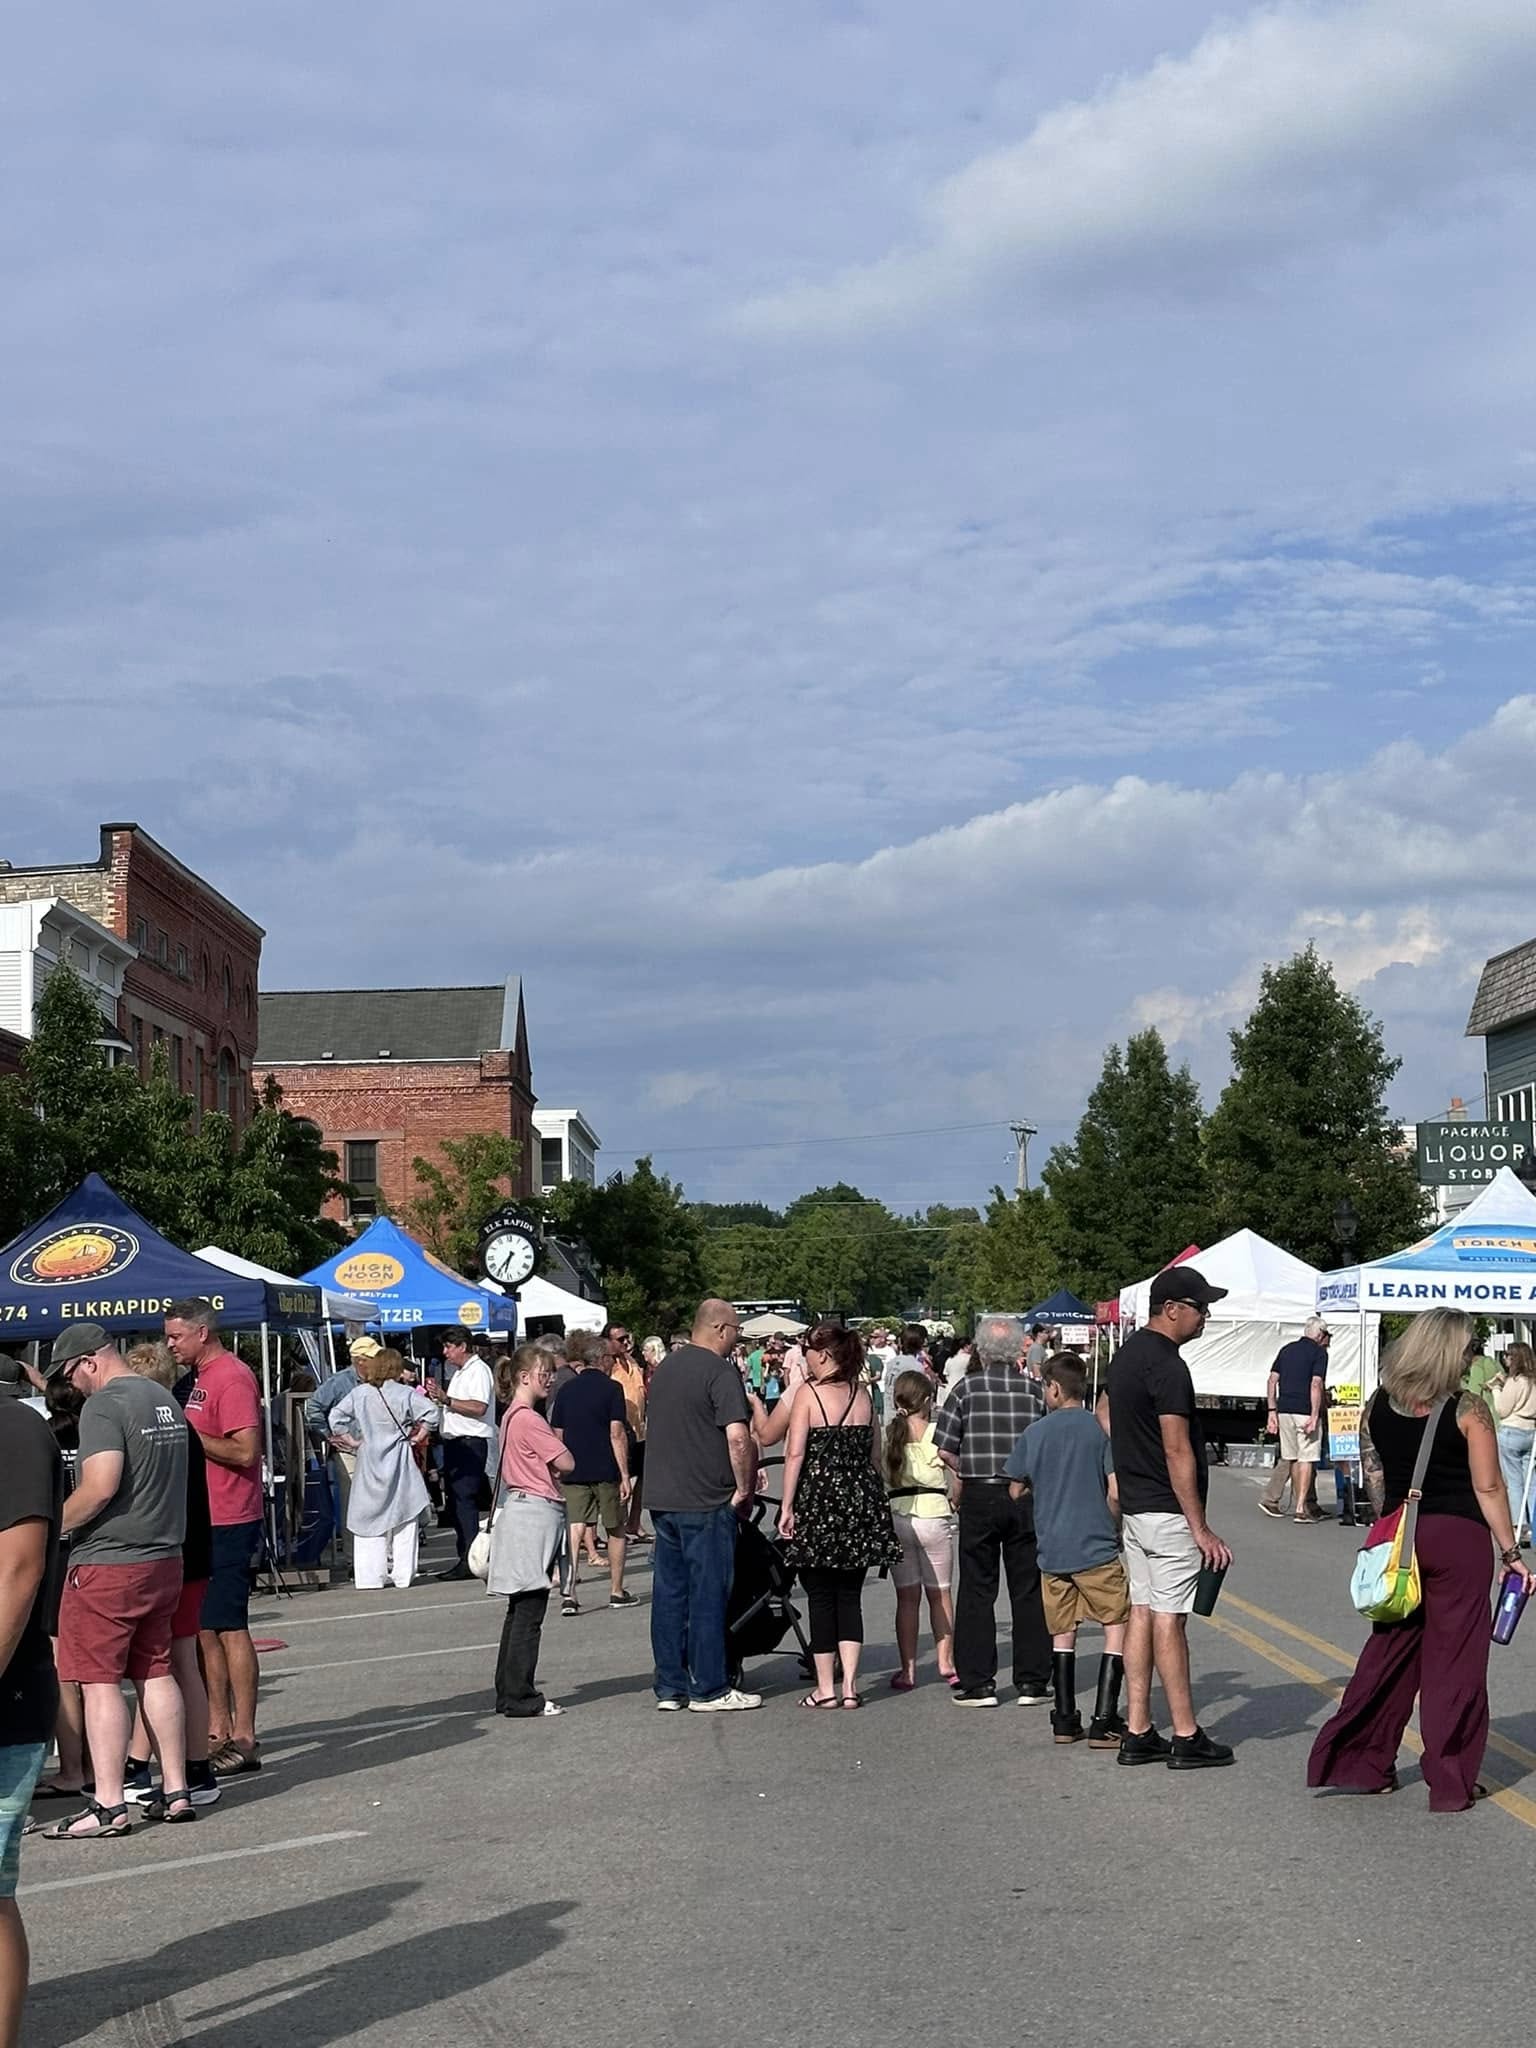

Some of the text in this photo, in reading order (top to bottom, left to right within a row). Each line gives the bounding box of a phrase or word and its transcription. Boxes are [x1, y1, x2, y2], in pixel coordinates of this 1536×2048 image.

[1440, 1126, 1510, 1138] PACKAGE
[1425, 1144, 1525, 1163] LIQUOR
[483, 1219, 535, 1234] ELK RAPIDS
[348, 1263, 393, 1272] HIGH
[342, 1271, 394, 1280] NOON
[1368, 1282, 1447, 1299] LEARN
[1453, 1284, 1522, 1300] MORE
[0, 1295, 225, 1321] 74 ELKRAPIDSG
[381, 1308, 424, 1323] TZER
